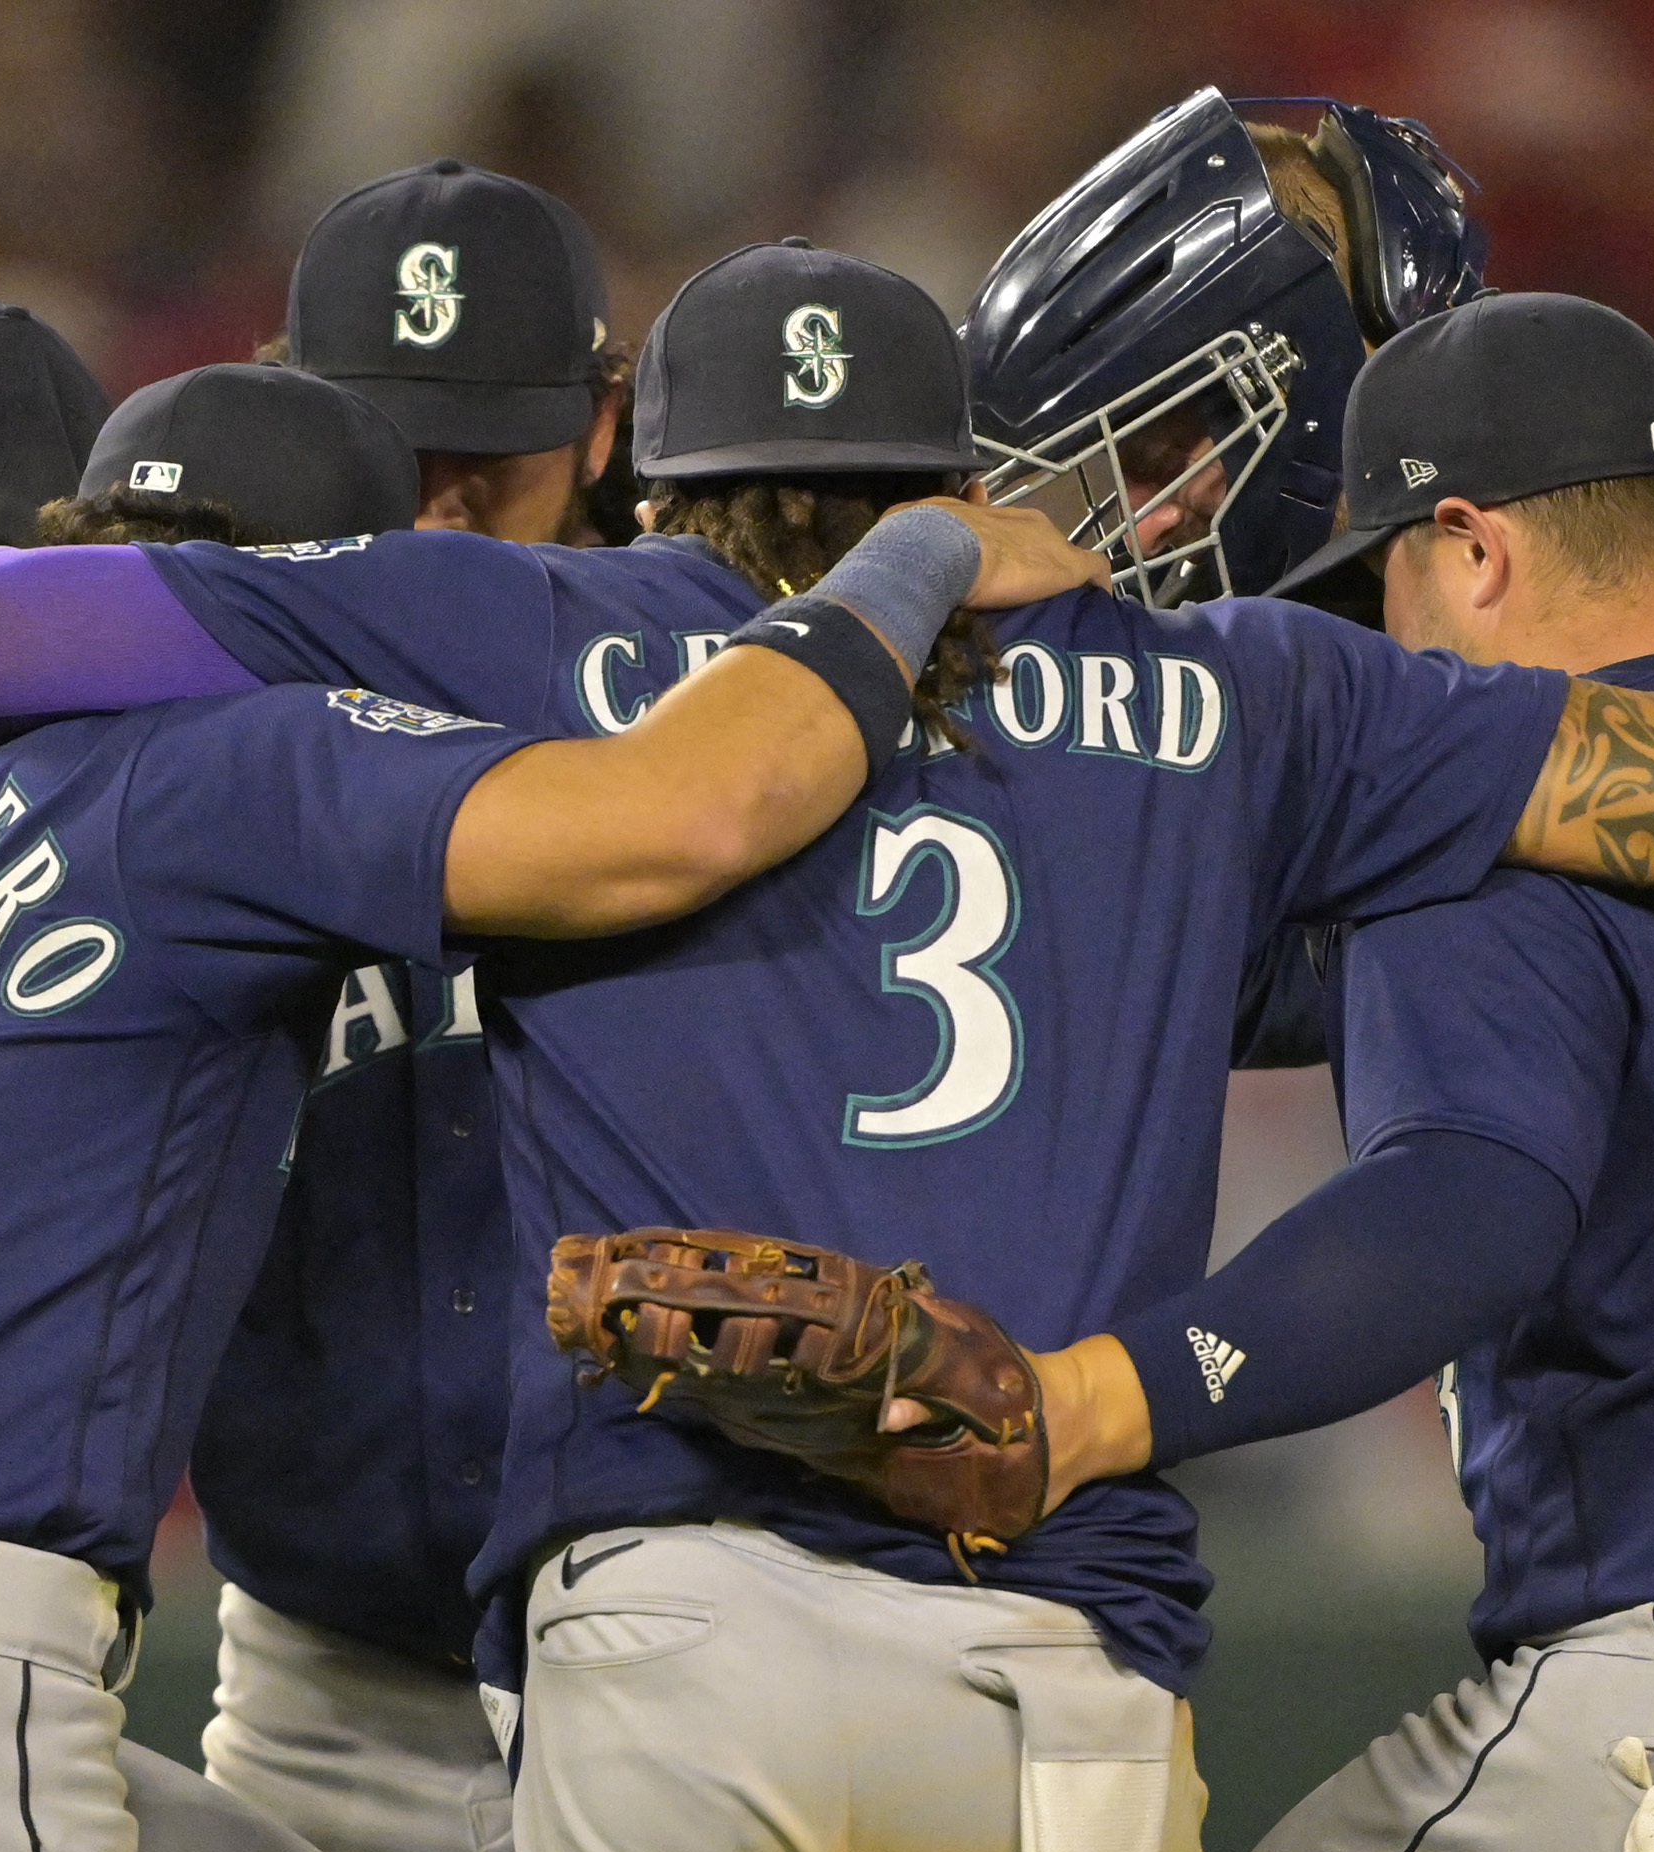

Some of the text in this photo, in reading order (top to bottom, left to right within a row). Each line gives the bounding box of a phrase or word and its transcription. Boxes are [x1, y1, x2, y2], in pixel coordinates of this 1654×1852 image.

[393, 241, 464, 349] S
[782, 303, 853, 410] S
[842, 802, 1025, 1150] 3
[1186, 1326, 1224, 1404] adidas
